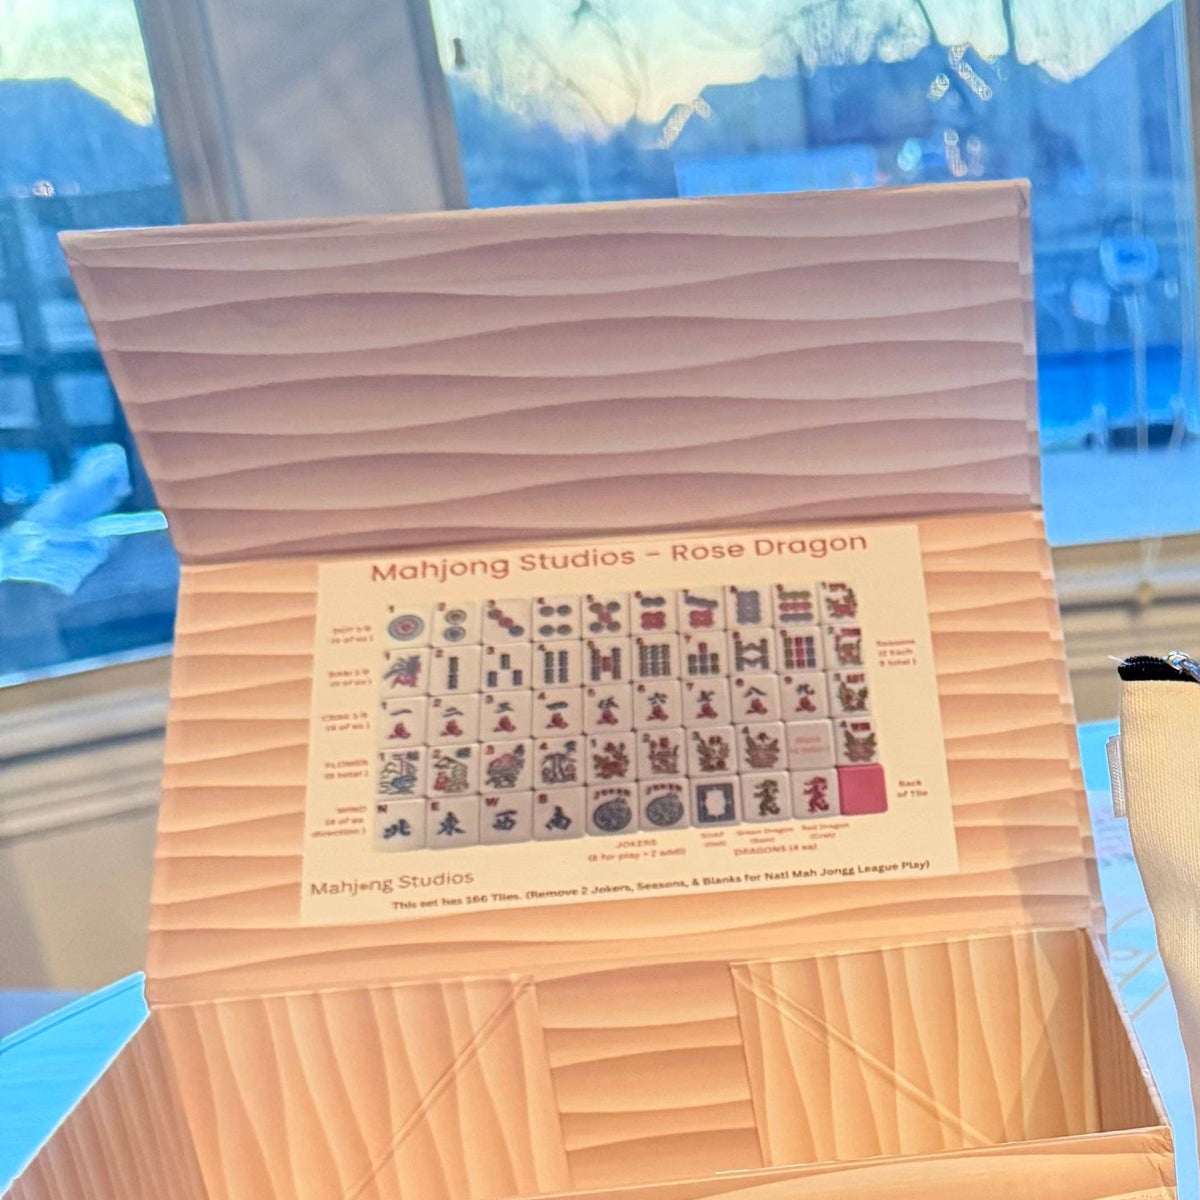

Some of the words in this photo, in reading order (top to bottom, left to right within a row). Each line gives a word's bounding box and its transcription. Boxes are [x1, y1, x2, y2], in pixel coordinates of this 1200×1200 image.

[371, 558, 510, 583] Mahjong
[520, 549, 635, 572] Studios
[672, 543, 745, 561] Rose
[754, 534, 867, 558] Dragon
[400, 871, 474, 890] Studios
[745, 873, 761, 883] for
[792, 868, 817, 879] Mah
[820, 867, 856, 877] Jongg
[857, 863, 899, 875] League
